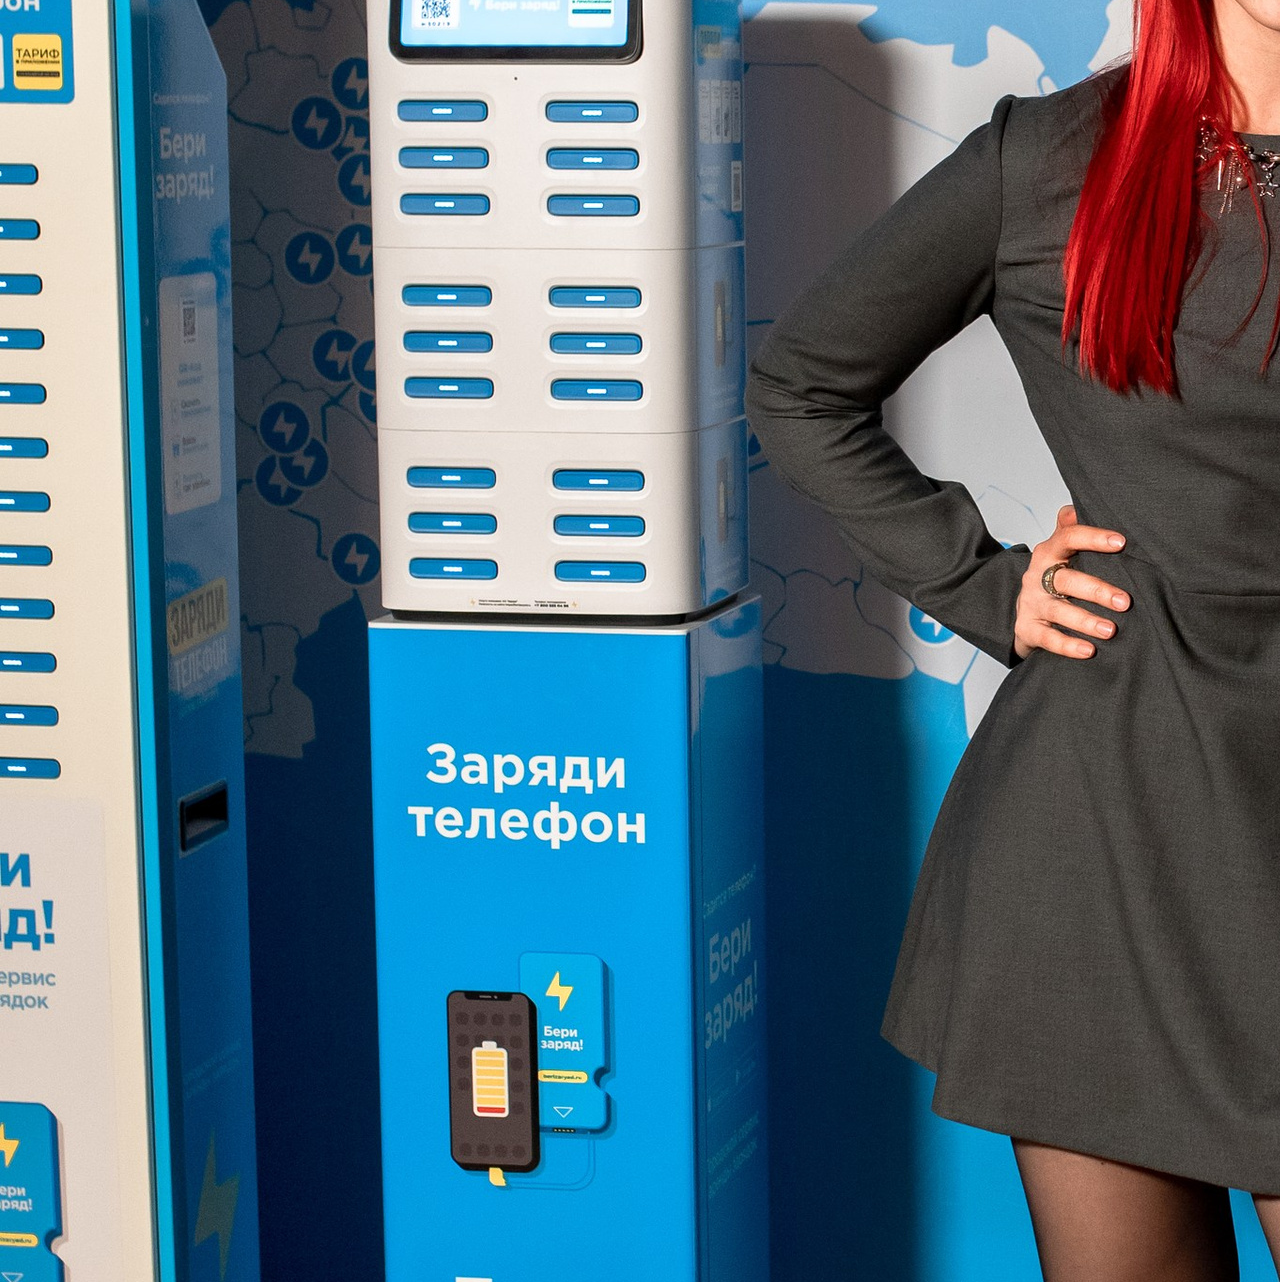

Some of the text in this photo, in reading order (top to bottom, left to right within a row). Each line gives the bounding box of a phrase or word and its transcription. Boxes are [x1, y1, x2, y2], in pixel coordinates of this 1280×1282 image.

[16, 48, 60, 59] ТАРИФ
[160, 126, 206, 164] Бери
[156, 165, 214, 205] заряд!
[426, 743, 625, 794] Заряди
[408, 802, 645, 849] телефон
[709, 919, 751, 985] Бери
[0, 971, 56, 987] ервис
[0, 994, 48, 1010] ядок
[705, 960, 758, 1049] заряд!
[543, 1025, 578, 1039] Бери
[540, 1037, 584, 1051] заряд!
[0, 1186, 26, 1198] ери
[0, 1199, 33, 1212] ряд!
